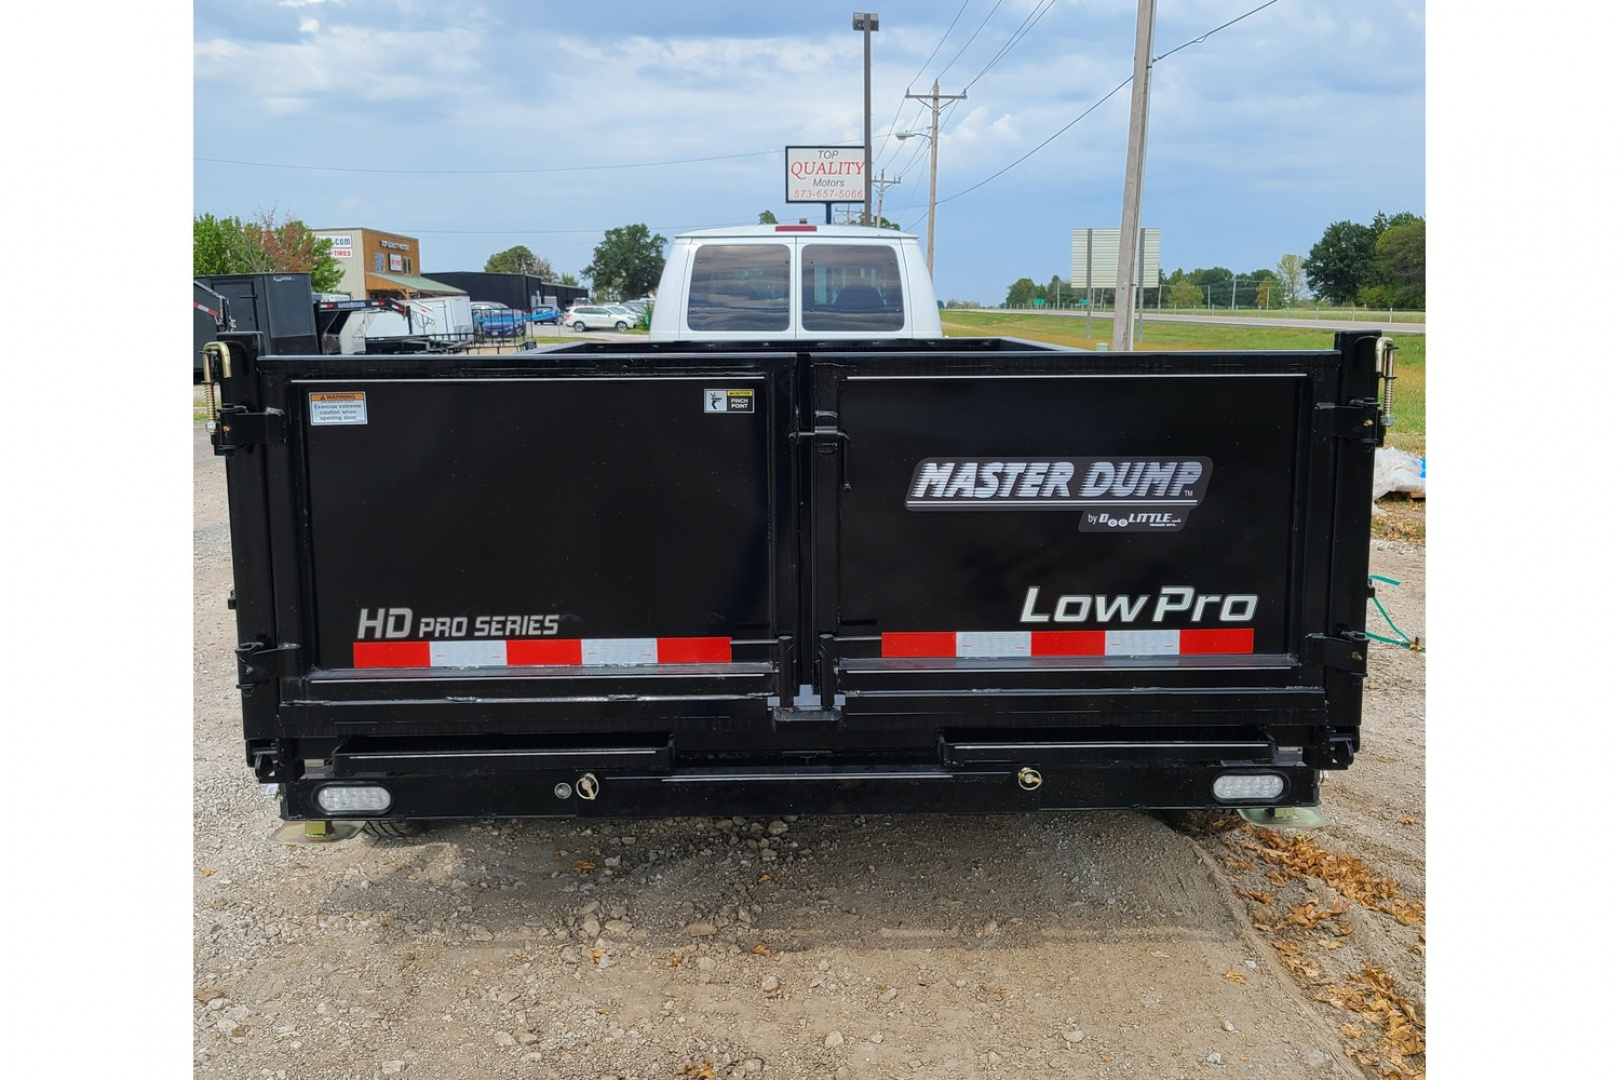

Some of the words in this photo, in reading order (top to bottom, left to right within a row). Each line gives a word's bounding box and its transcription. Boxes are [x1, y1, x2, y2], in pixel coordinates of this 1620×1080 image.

[818, 150, 839, 160] TOP
[790, 161, 865, 180] QUALITY
[812, 178, 845, 188] Motors
[794, 190, 864, 199] 573-657-5066
[910, 462, 1075, 498] MASTER
[1078, 461, 1203, 497] DUMP
[1088, 513, 1098, 525] by
[357, 607, 414, 640] HD
[418, 617, 469, 638] PRO
[473, 614, 561, 637] SERIES
